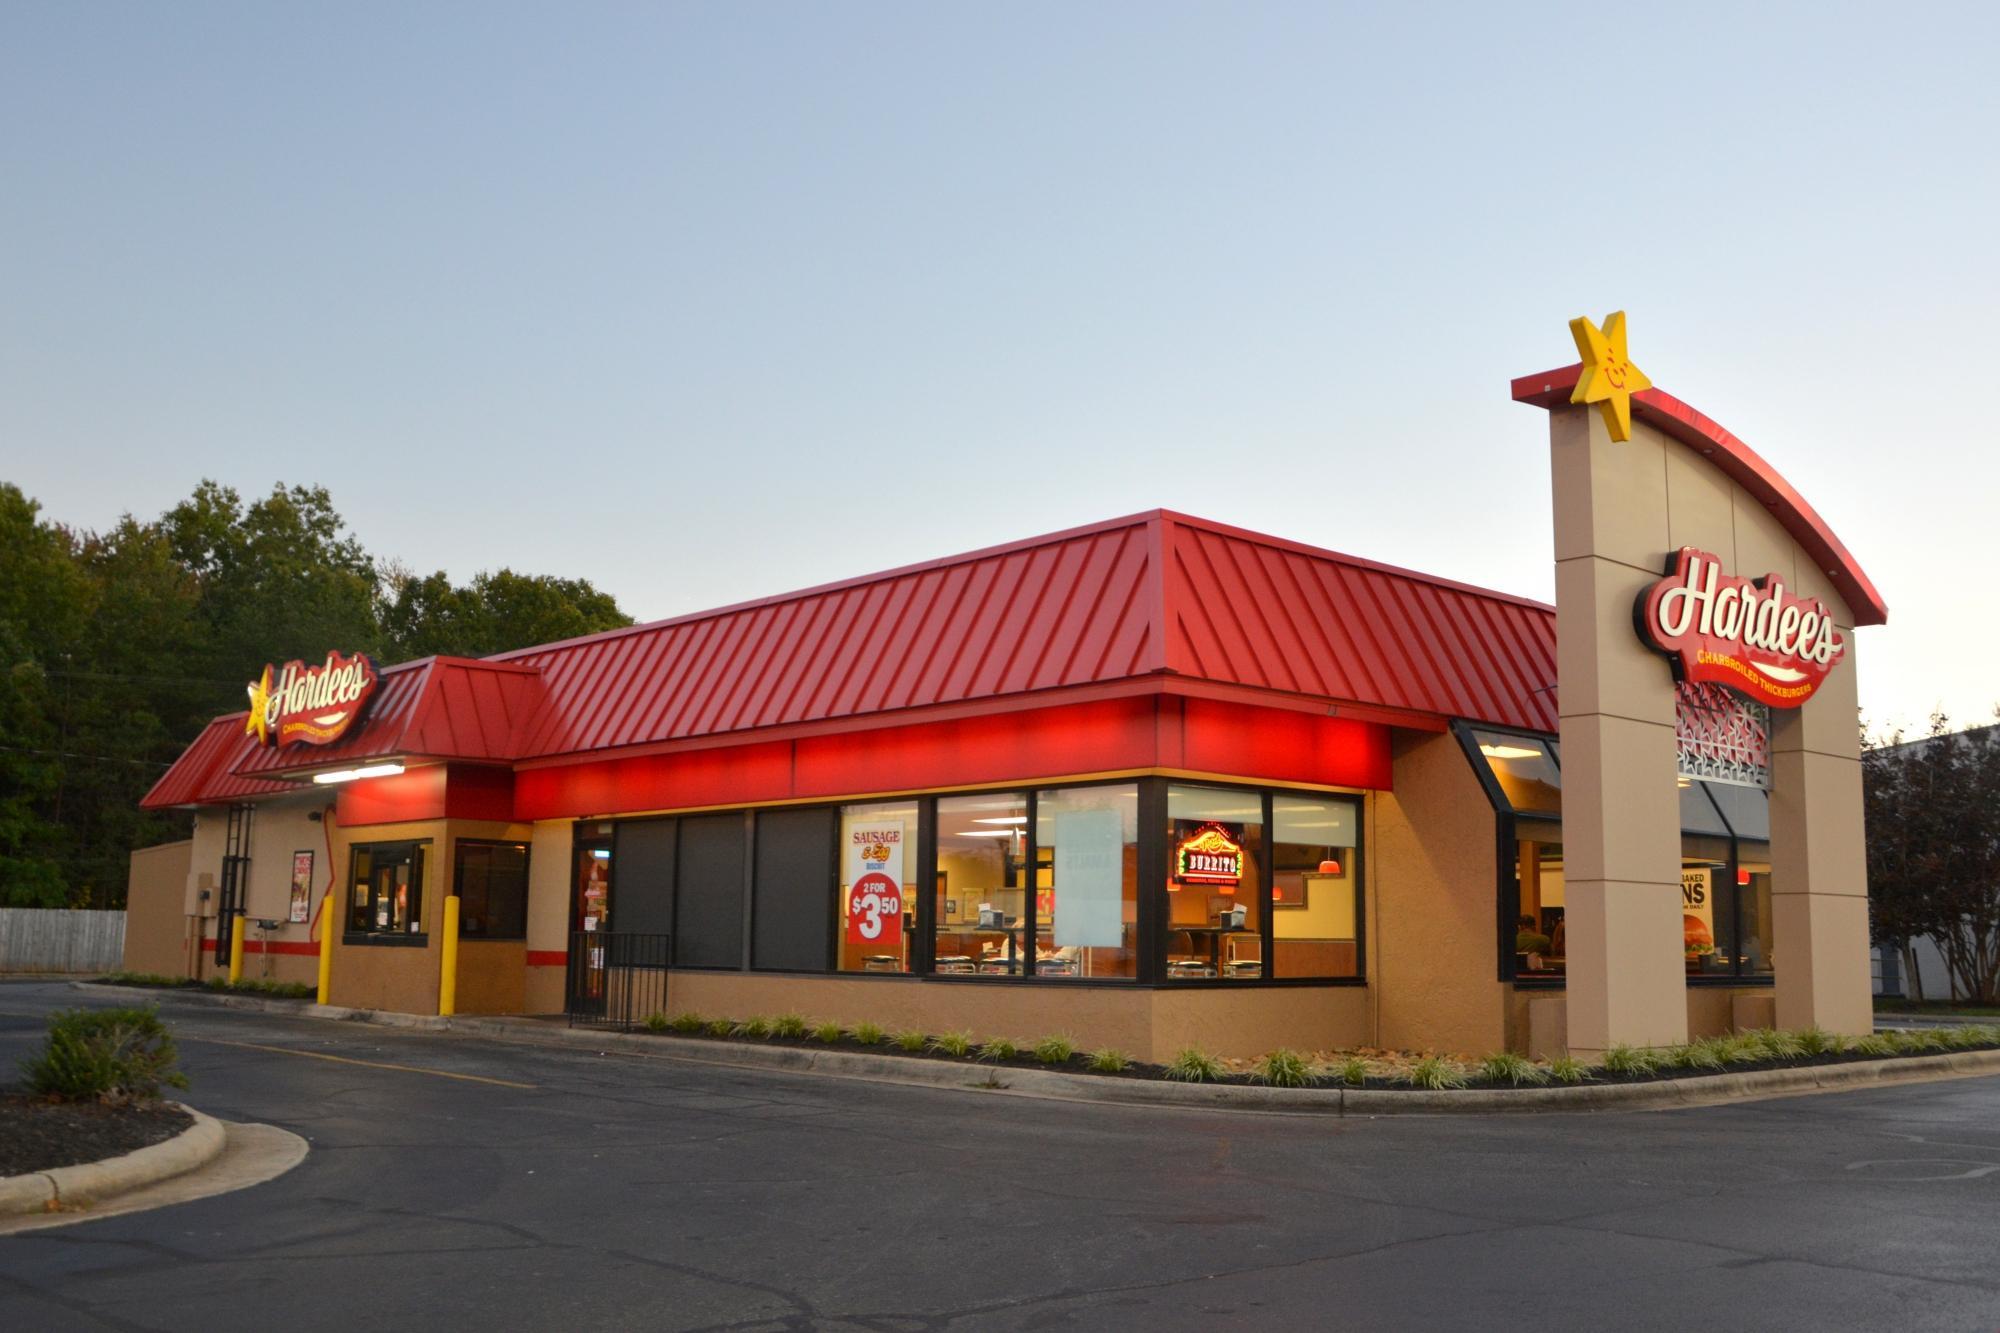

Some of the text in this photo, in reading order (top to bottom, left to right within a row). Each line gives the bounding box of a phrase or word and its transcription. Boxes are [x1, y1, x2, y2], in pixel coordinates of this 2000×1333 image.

[1659, 556, 1843, 664] Hardee's
[1697, 649, 1758, 684] CHARBROILED
[266, 654, 370, 727] Hardee's
[853, 831, 900, 844] SAUSAGE
[1189, 854, 1236, 873] BURRITO
[863, 883, 886, 893] 2 FOR
